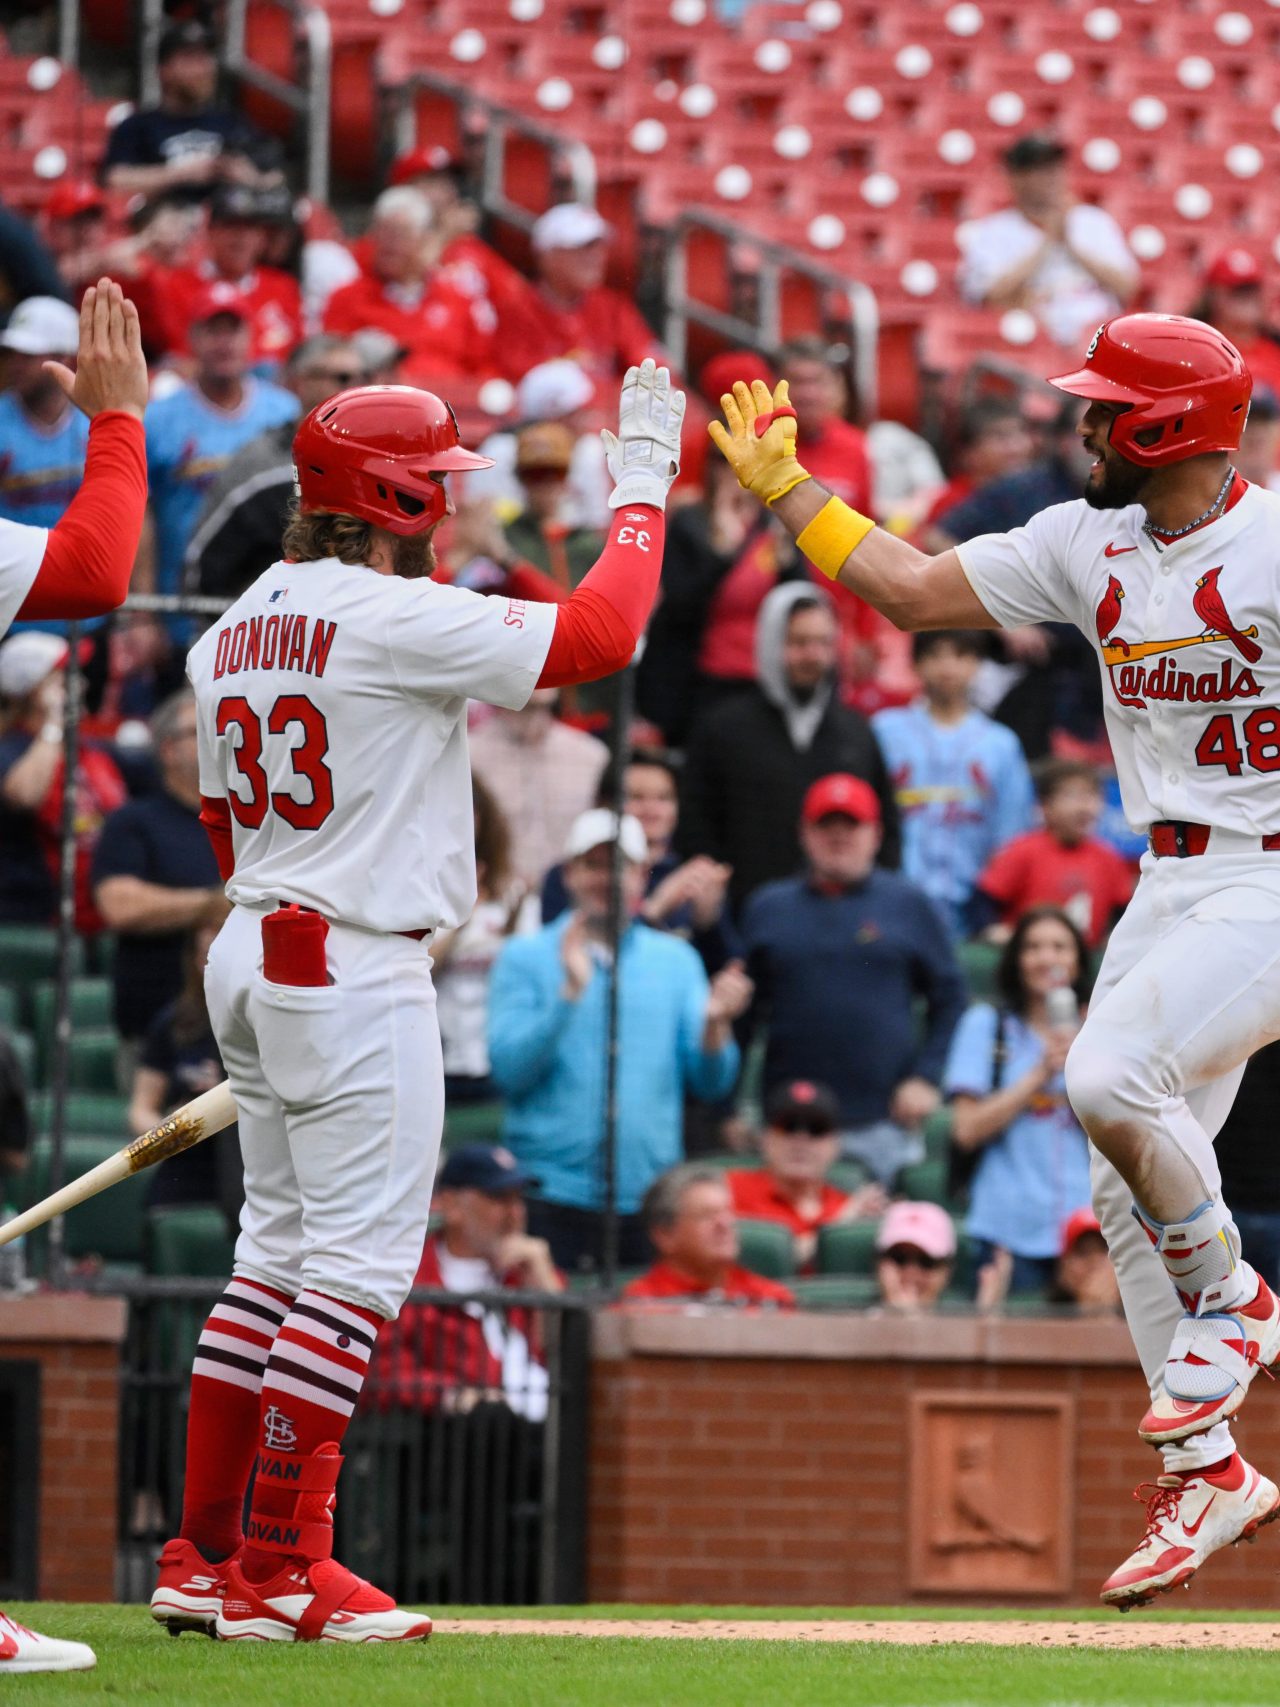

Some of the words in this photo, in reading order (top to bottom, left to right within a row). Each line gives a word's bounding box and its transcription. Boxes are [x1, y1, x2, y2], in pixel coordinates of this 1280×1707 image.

[213, 614, 337, 681] DONOVAN
[1108, 657, 1265, 710] Cardinals
[216, 694, 335, 831] 33
